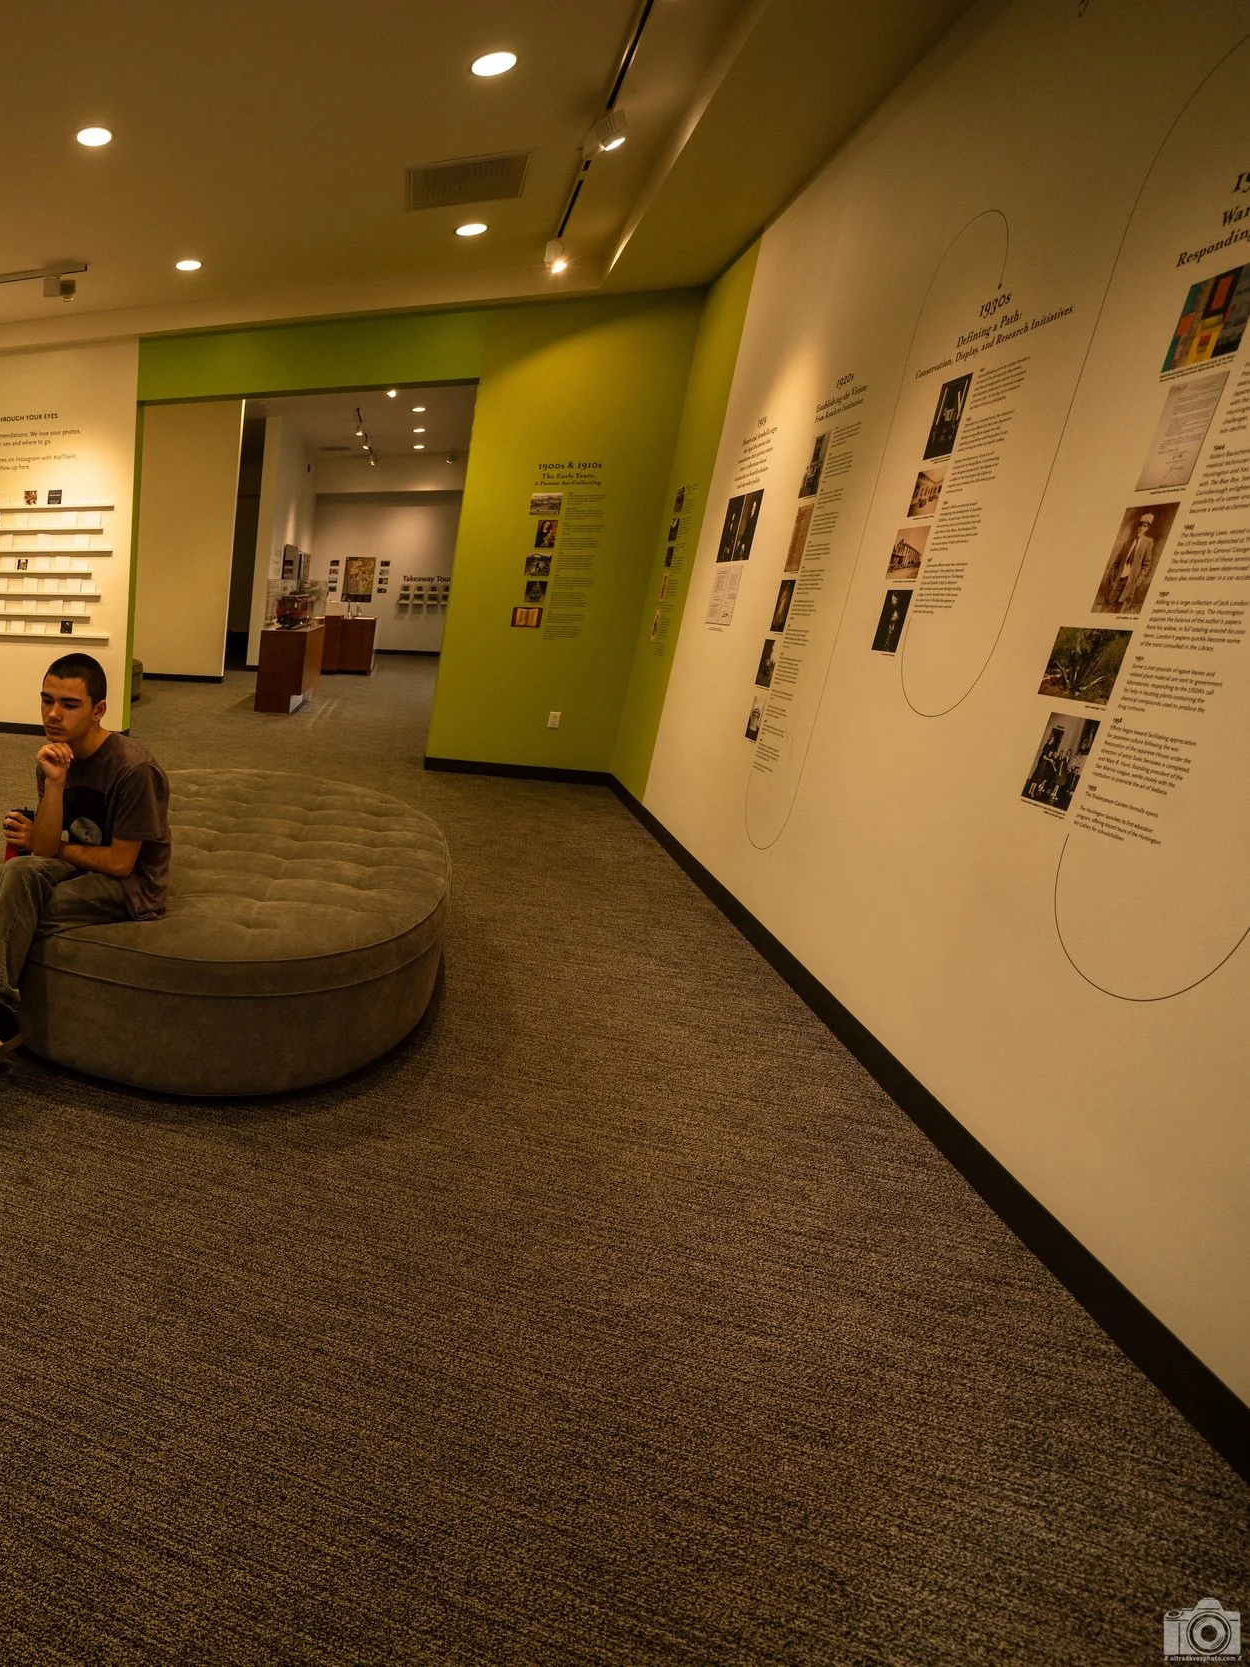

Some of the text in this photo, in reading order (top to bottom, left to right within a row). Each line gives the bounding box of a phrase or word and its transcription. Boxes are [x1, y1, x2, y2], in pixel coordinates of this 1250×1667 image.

[980, 292, 1012, 319] 1930s
[956, 327, 992, 348] Defining
[999, 310, 1022, 328] Path:
[916, 307, 1073, 379] Conservation, Display, and Research Initiatives
[836, 373, 854, 390] 1920s
[816, 397, 843, 412] Establishing
[852, 385, 868, 395] Vision:
[825, 408, 837, 419] Ranch
[842, 399, 864, 411] Institution
